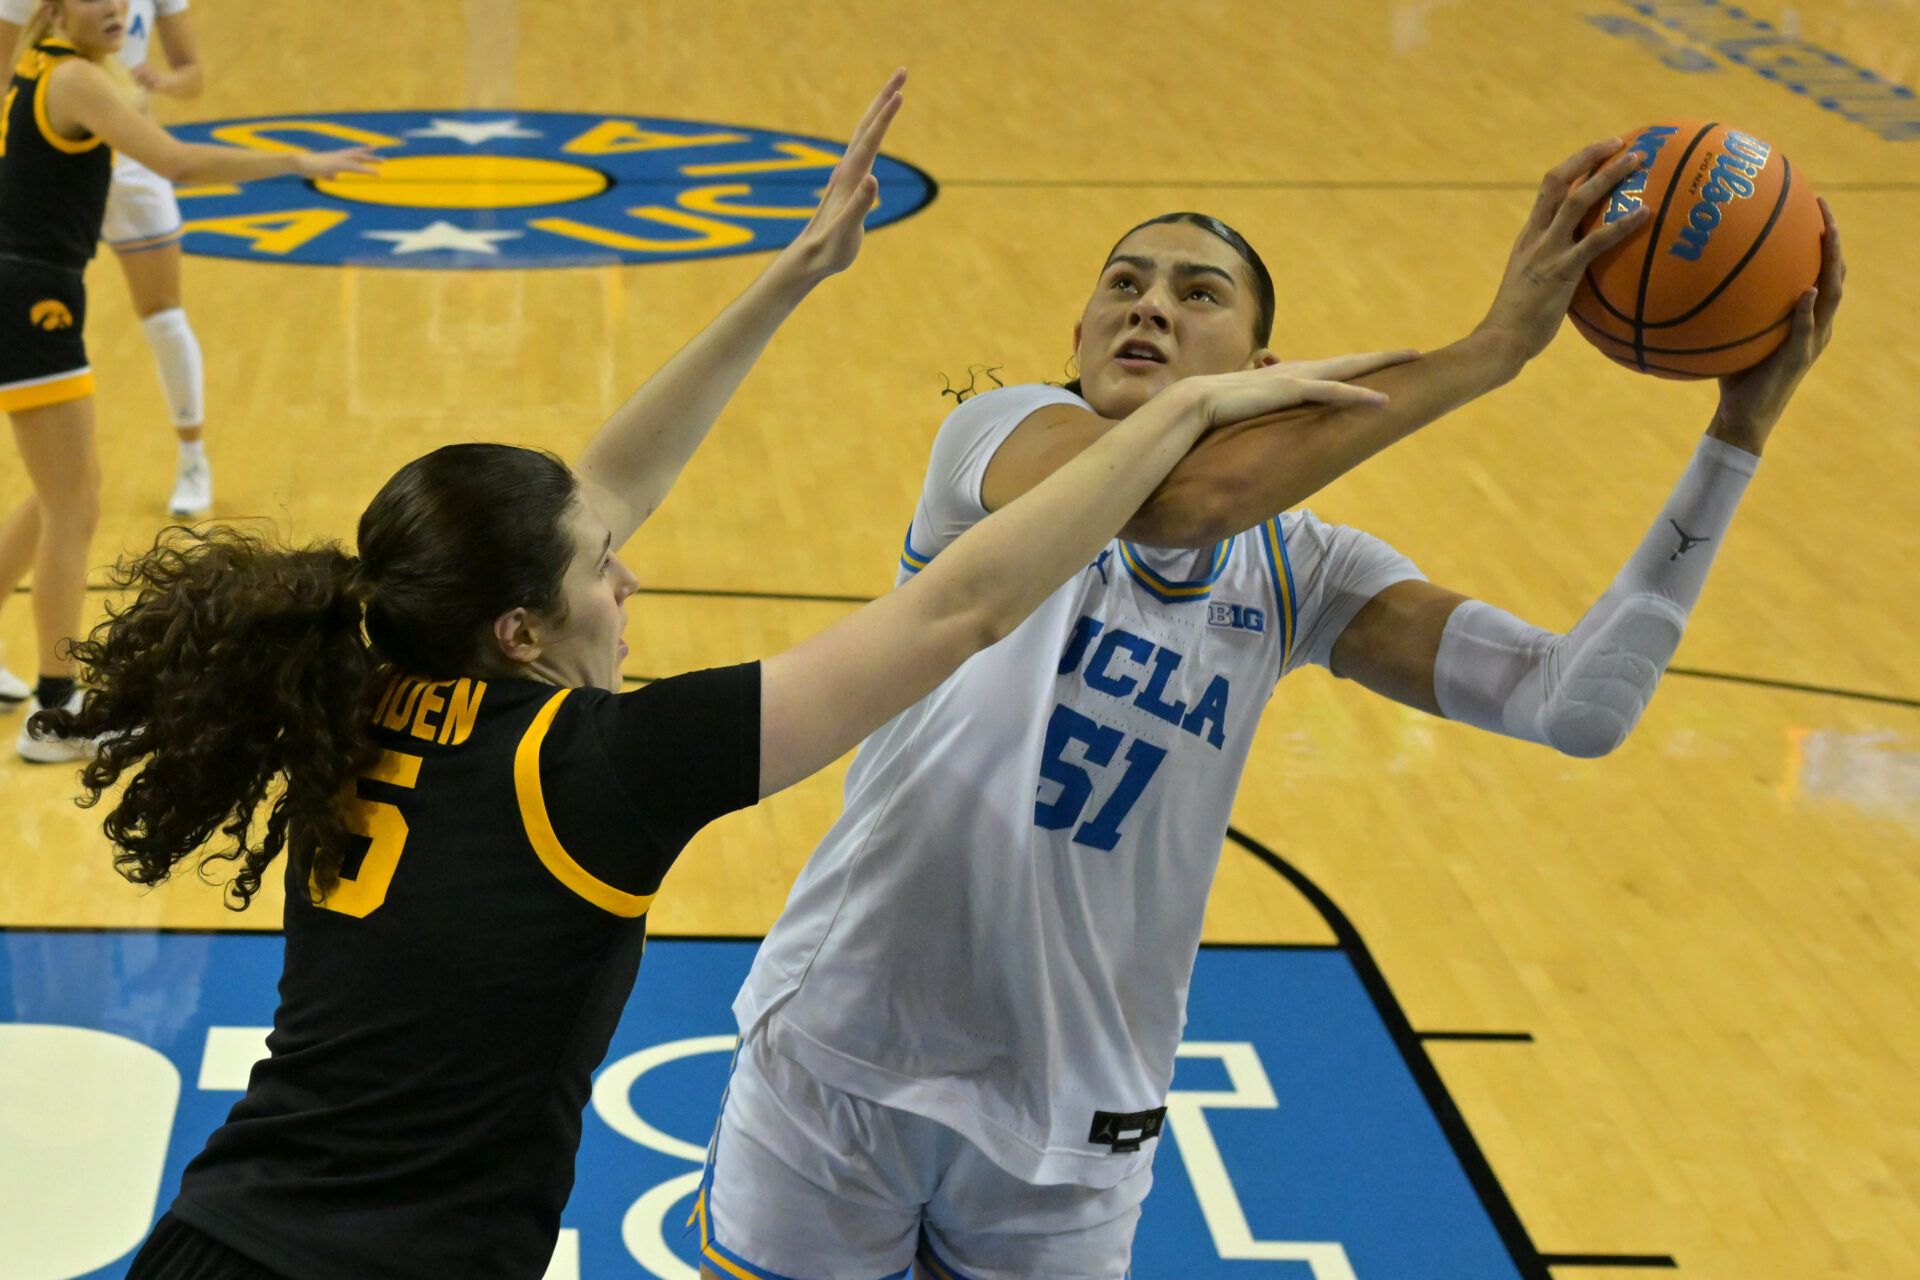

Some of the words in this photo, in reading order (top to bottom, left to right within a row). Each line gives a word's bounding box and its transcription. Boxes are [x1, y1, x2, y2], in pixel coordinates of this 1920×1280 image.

[1669, 129, 1772, 262] Wilson
[307, 748, 424, 919] 5
[1033, 703, 1168, 852] 51
